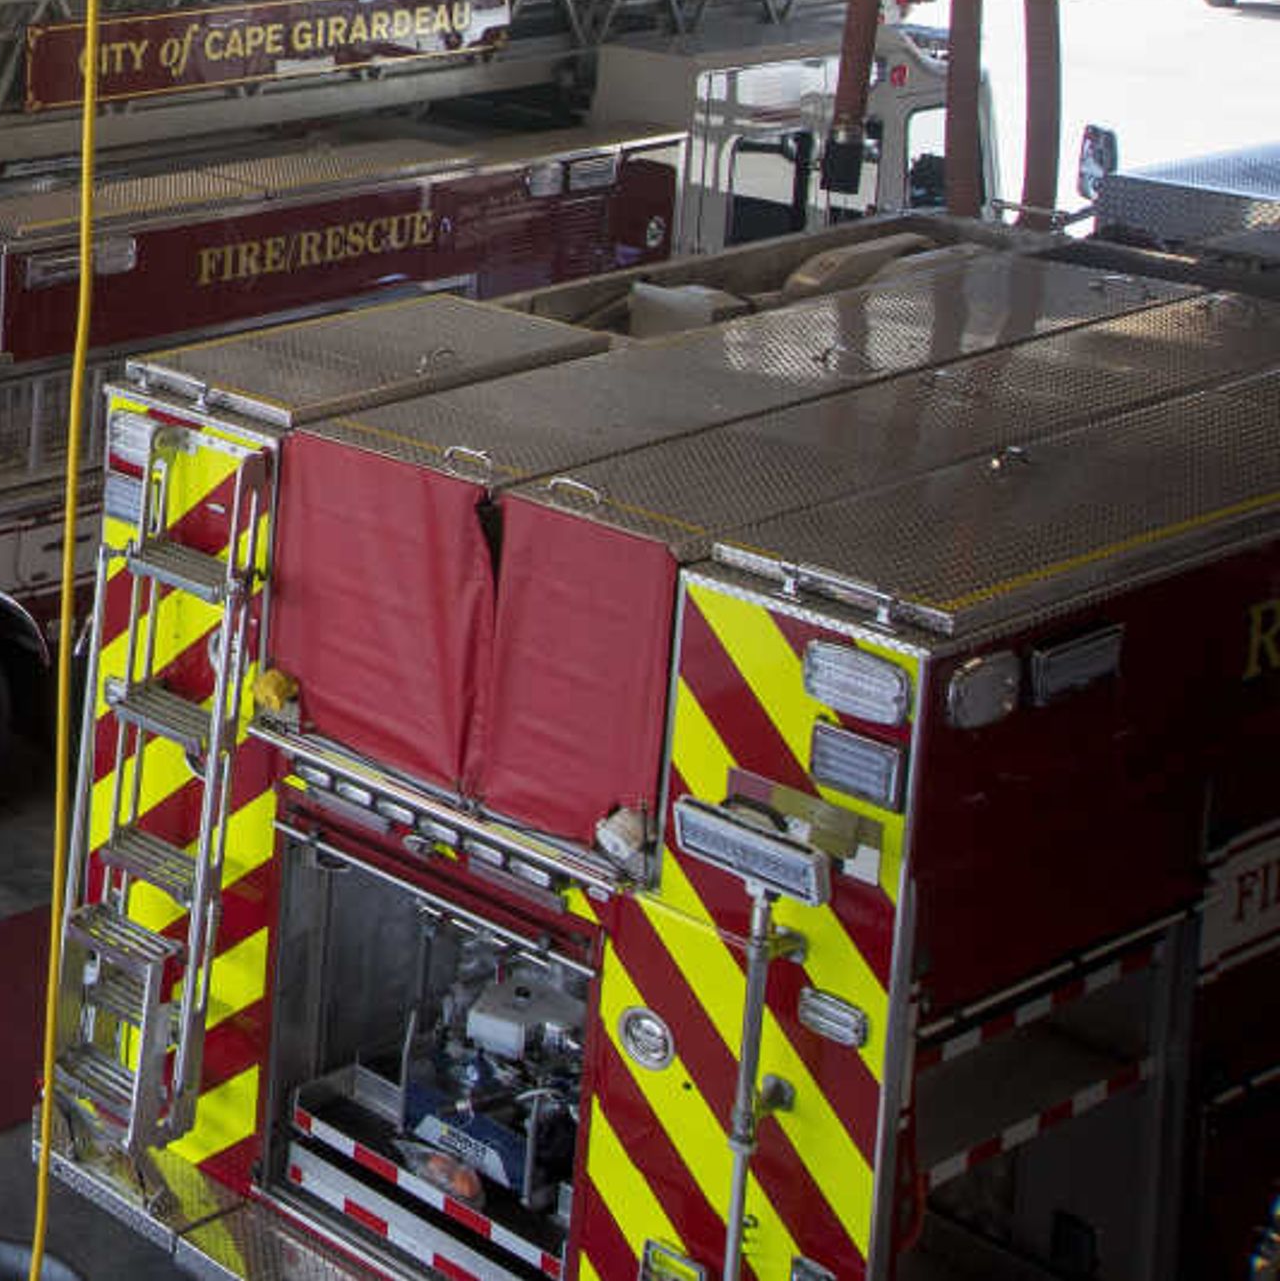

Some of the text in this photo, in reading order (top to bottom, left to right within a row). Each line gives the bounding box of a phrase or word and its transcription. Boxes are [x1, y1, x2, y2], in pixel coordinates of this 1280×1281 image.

[159, 23, 200, 77] of
[204, 23, 284, 61] CAPE
[292, 1, 473, 52] GIRARDEAU
[1232, 858, 1280, 925] FI
